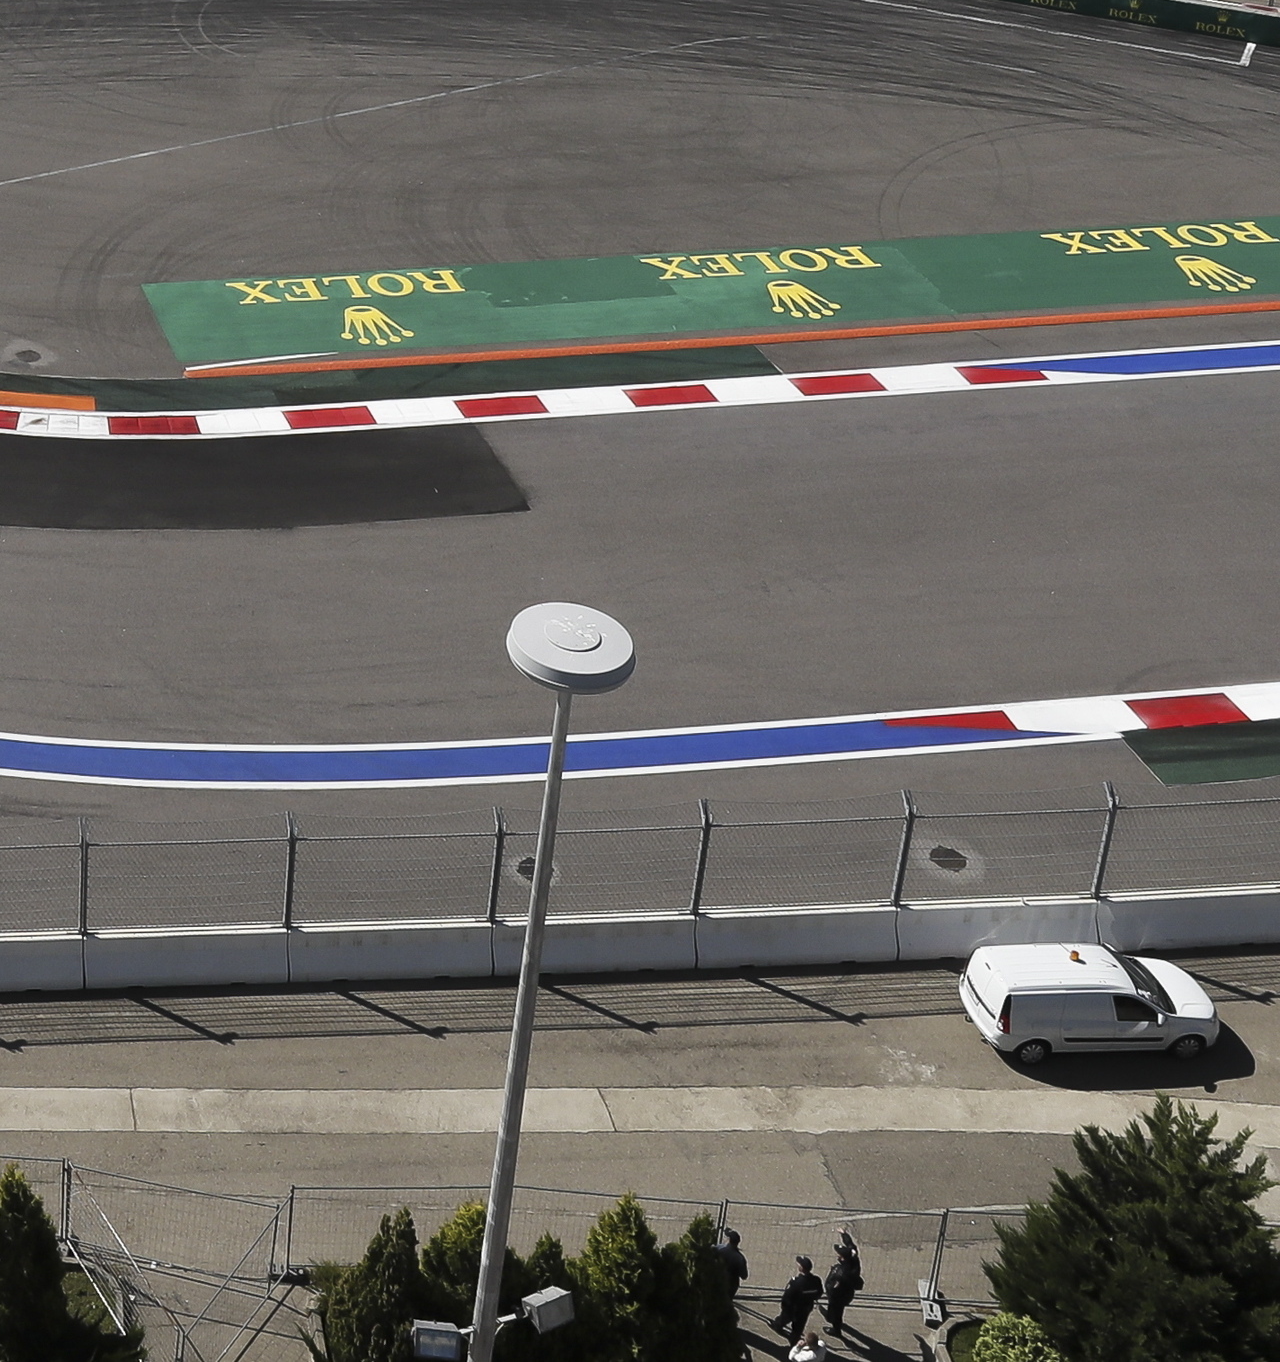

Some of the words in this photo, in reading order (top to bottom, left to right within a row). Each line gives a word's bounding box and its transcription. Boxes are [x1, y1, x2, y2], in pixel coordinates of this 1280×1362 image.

[1109, 8, 1157, 24] ROLEX
[1196, 21, 1246, 38] ROLEX
[1041, 222, 1280, 255] ROLEX
[640, 246, 883, 281] ROLEX
[225, 269, 466, 305] ROLEX
